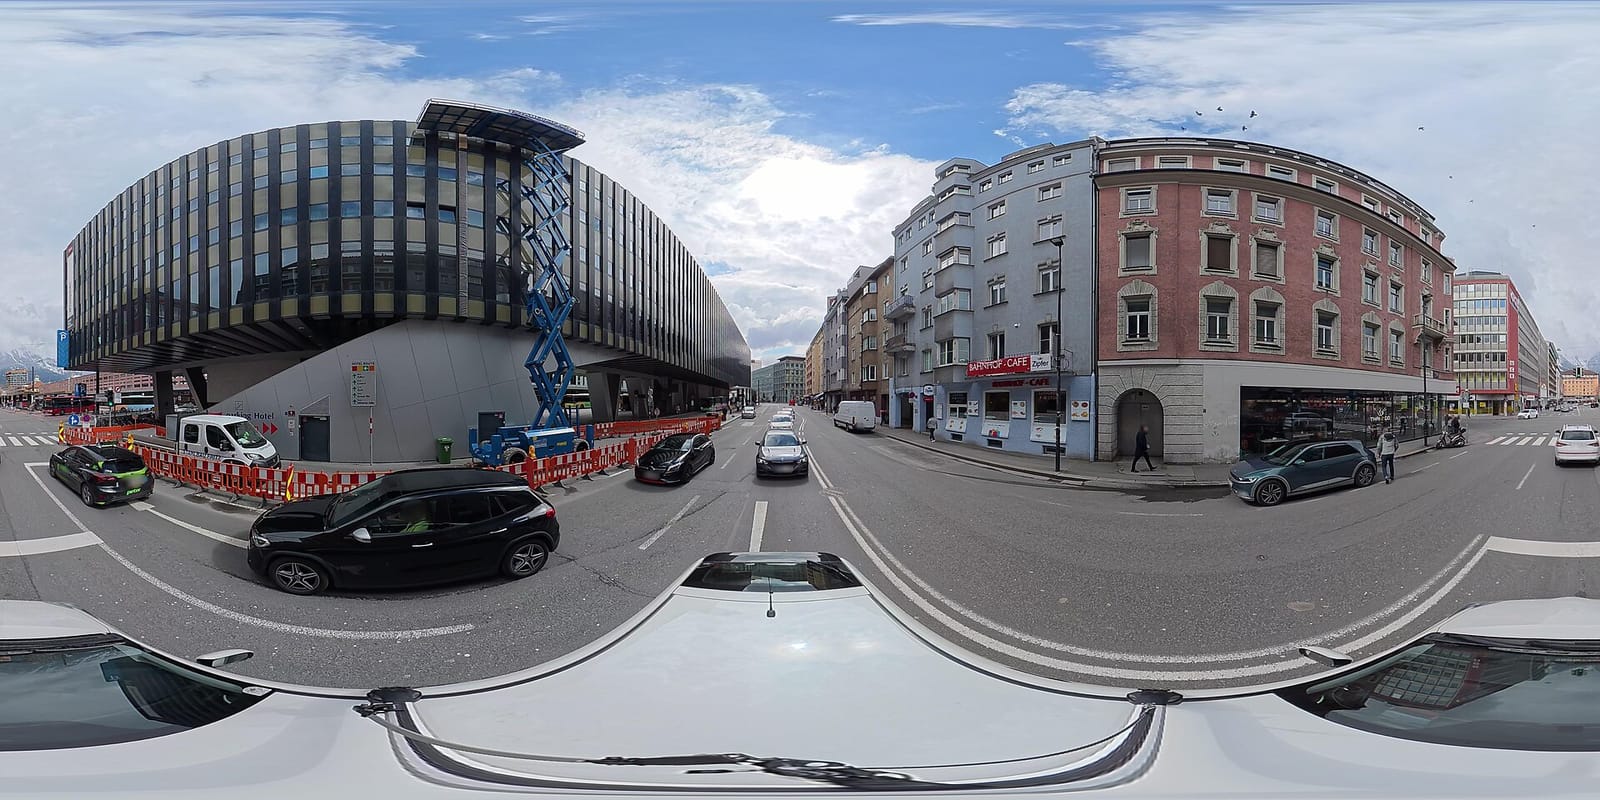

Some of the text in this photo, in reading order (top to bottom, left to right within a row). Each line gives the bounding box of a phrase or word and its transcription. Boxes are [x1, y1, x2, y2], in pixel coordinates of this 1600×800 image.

[969, 359, 1003, 371] BAHNHOF
[1007, 357, 1028, 368] CAFE
[1032, 360, 1049, 369] Zipfer
[254, 412, 274, 420] Hotel
